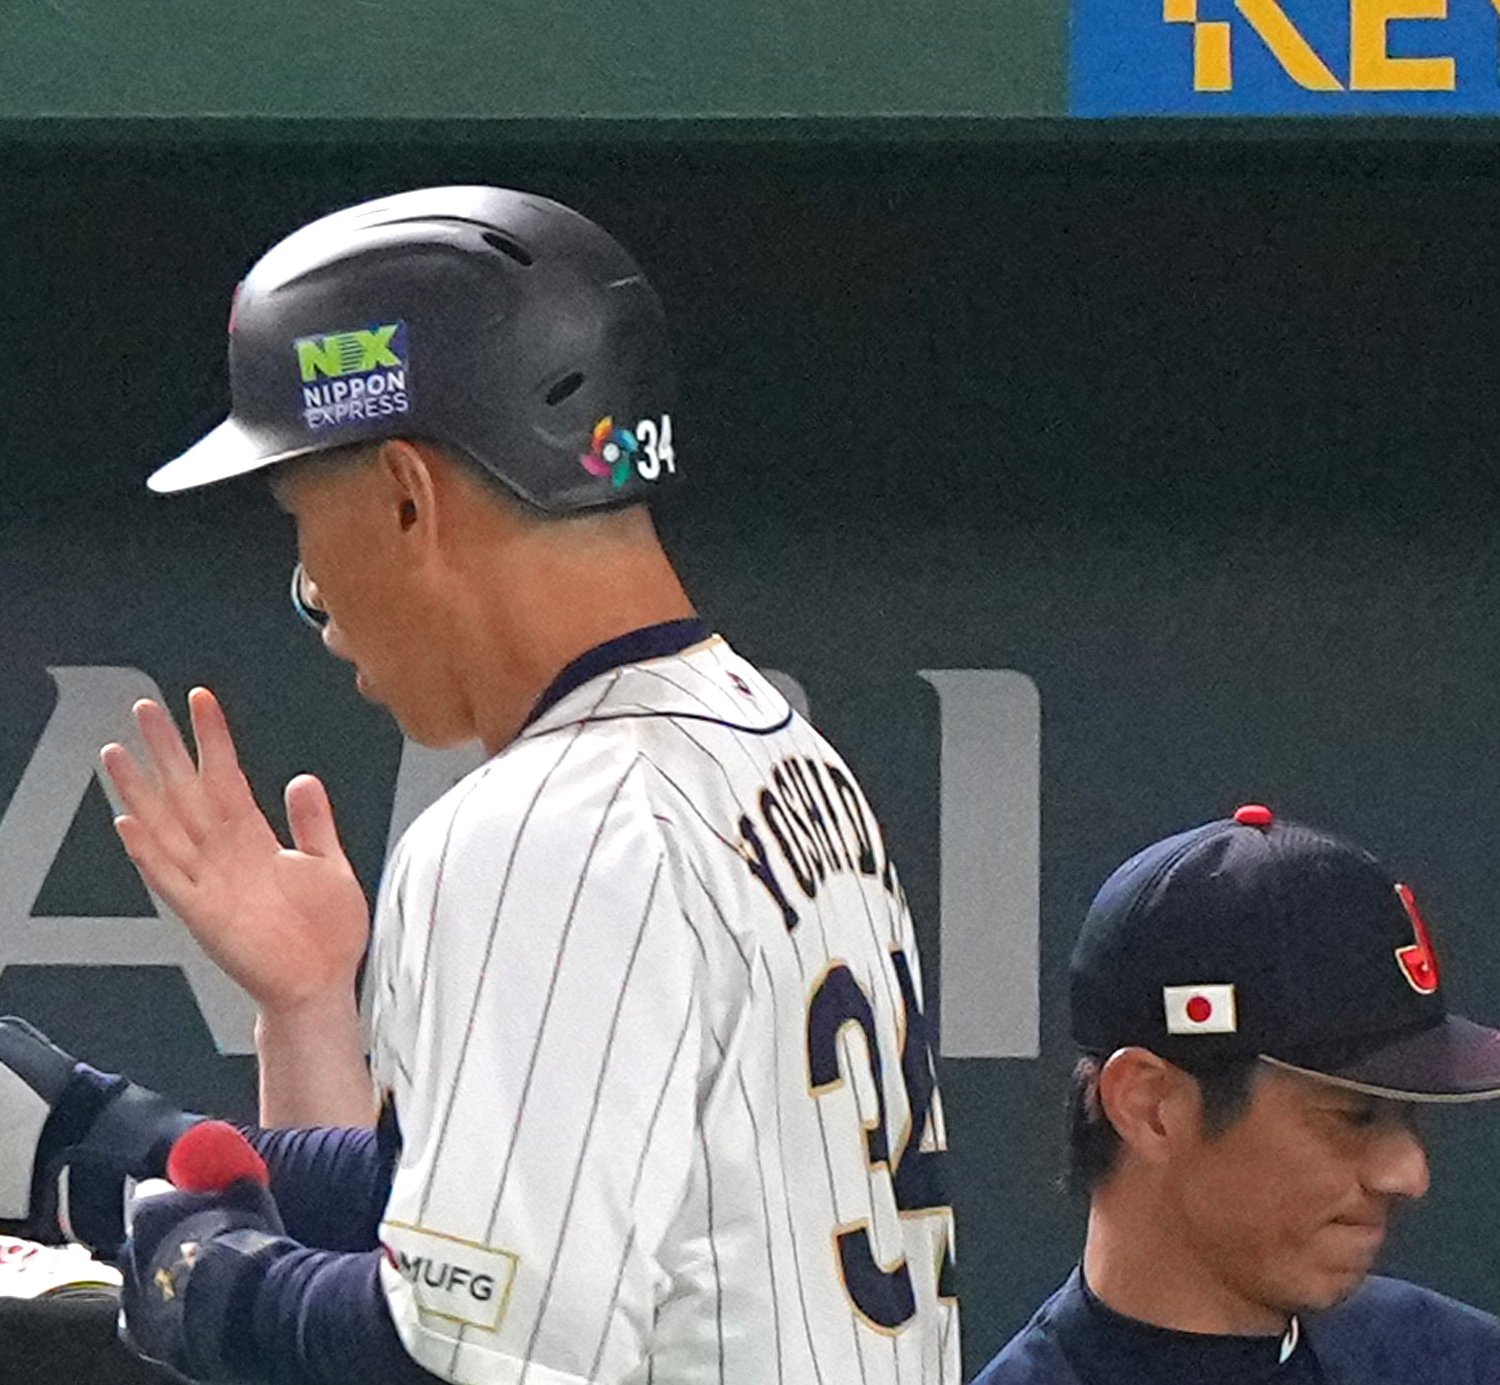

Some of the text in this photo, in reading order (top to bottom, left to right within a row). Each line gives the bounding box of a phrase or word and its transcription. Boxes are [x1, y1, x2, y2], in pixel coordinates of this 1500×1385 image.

[303, 370, 405, 407] NIPPON
[304, 393, 409, 428] EXPRESS
[636, 414, 676, 479] 34
[737, 756, 906, 933] YOSHID
[399, 1250, 495, 1301] MUFG
